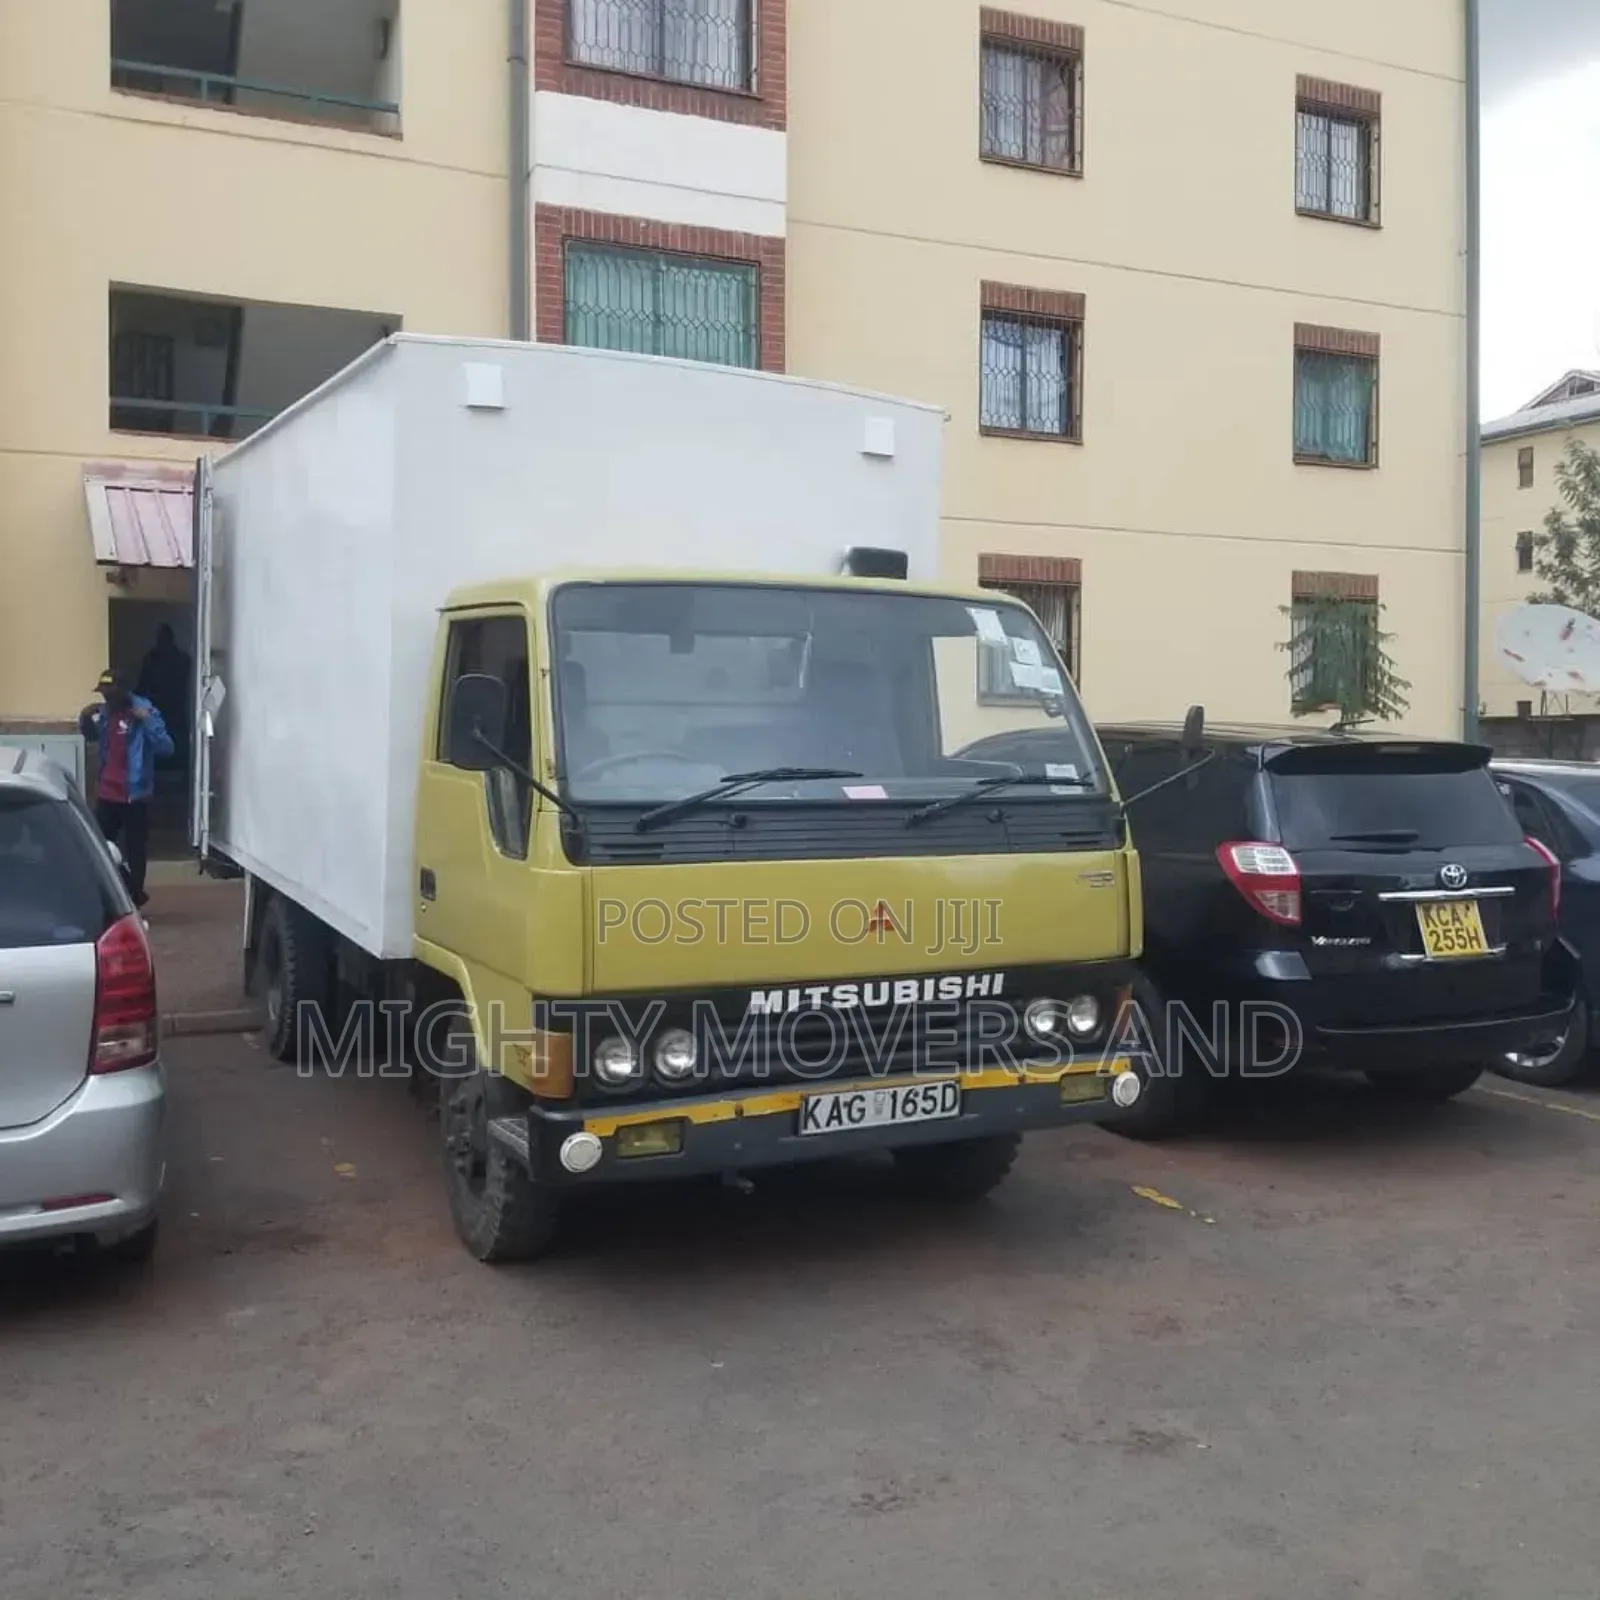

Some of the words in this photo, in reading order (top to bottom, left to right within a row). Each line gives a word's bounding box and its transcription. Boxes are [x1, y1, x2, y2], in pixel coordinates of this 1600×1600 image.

[1421, 903, 1463, 928] KCA
[1429, 926, 1482, 952] 255H
[750, 973, 1004, 1014] MITSUBISHI
[803, 1094, 866, 1130] KAG
[889, 1083, 958, 1121] 165D
